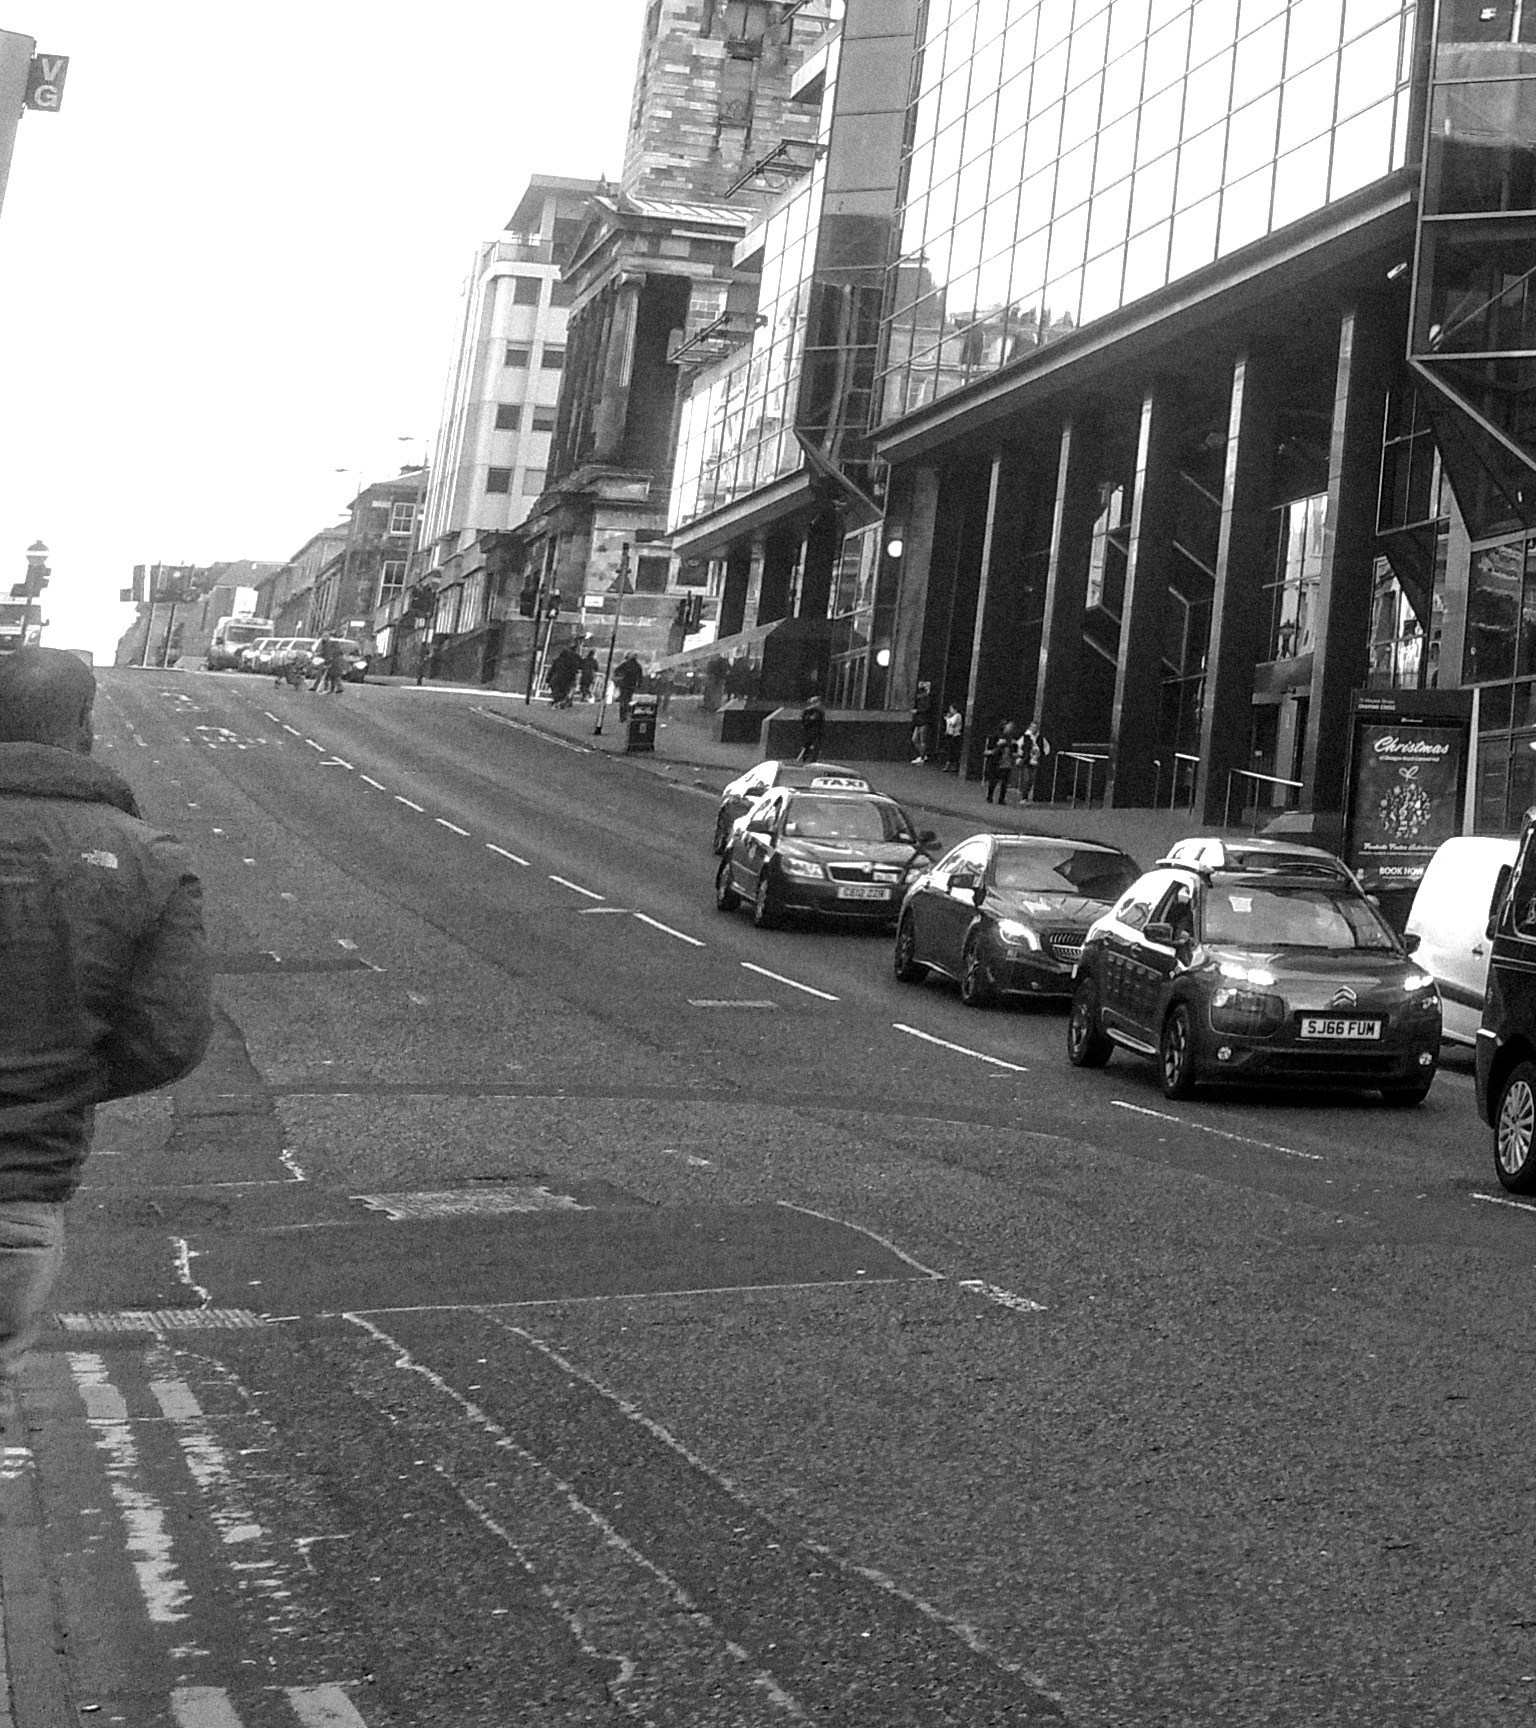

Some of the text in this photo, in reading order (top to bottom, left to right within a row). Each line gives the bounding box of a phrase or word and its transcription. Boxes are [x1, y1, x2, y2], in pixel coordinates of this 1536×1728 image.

[1374, 735, 1450, 754] Christmas
[822, 779, 865, 788] TAXI
[1379, 866, 1403, 875] BOOK
[1307, 1020, 1376, 1036] SJ66 FUM
